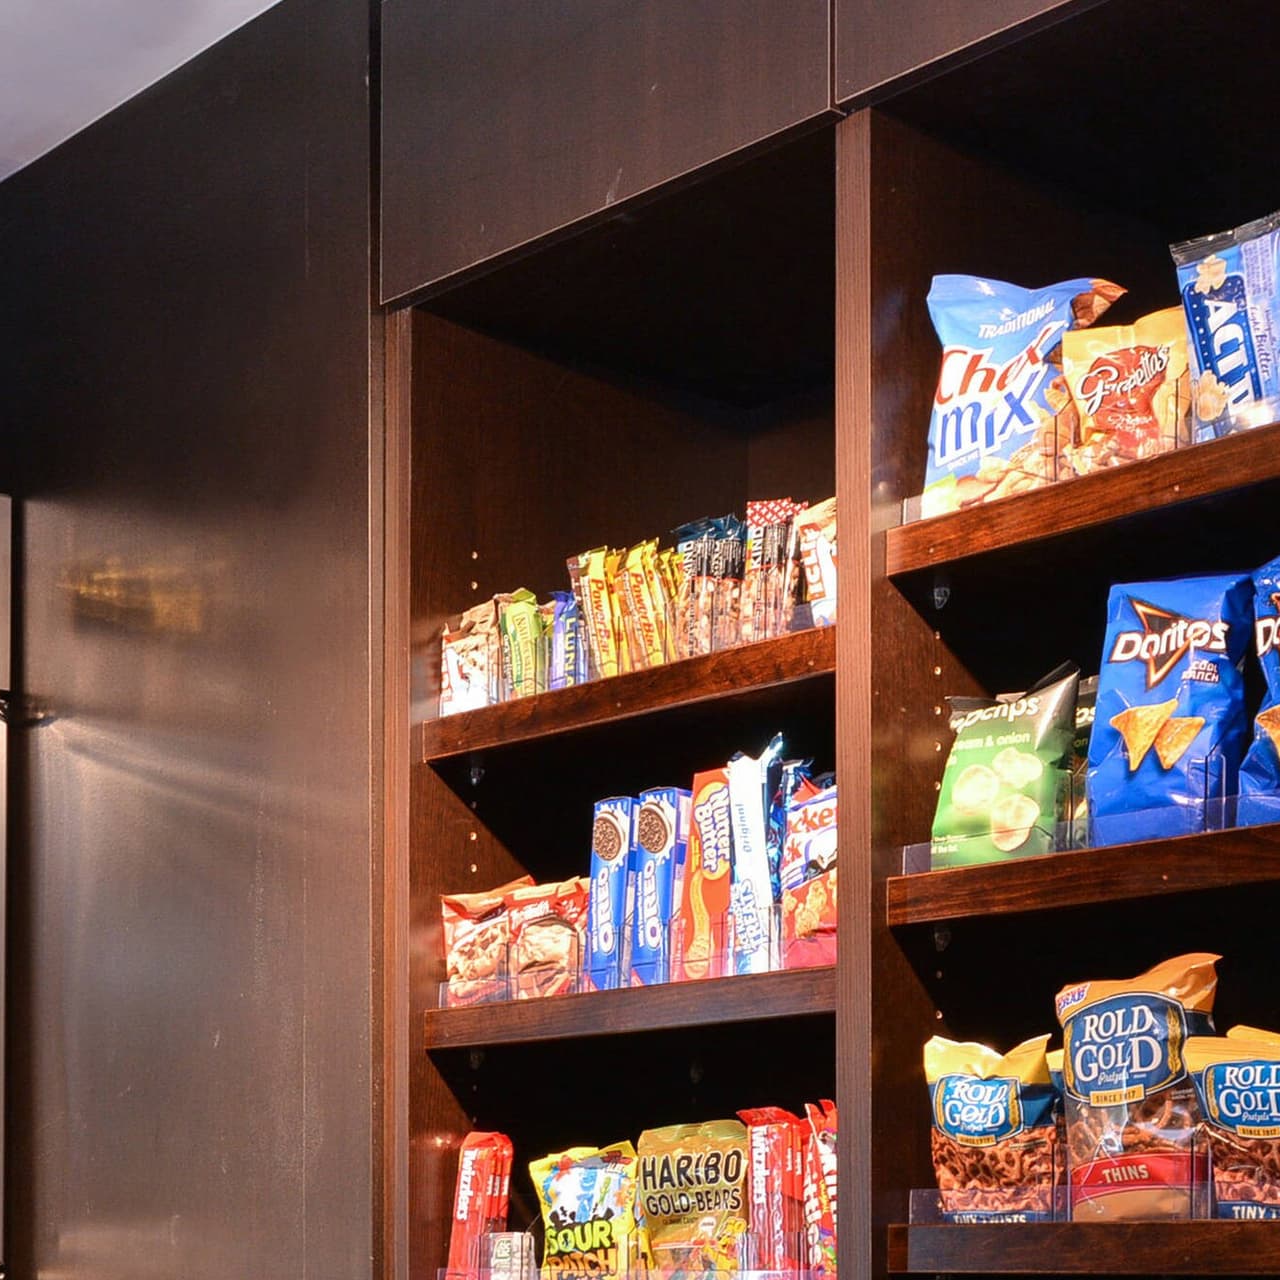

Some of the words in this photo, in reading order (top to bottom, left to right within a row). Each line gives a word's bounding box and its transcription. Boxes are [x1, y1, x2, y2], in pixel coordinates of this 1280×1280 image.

[978, 298, 1057, 339] TRADITIONAL
[935, 320, 1070, 406] Chex
[934, 364, 1048, 464] mix
[590, 579, 610, 655] PowerBar
[1109, 618, 1228, 664] Doritos
[1190, 659, 1220, 672] COOL
[596, 866, 616, 956] OREO
[643, 859, 663, 952] OREO
[1082, 1004, 1156, 1043] ROLD
[1074, 1035, 1163, 1083] GOLD
[641, 1149, 744, 1192] HARIBO
[1102, 1163, 1150, 1184] THINS
[645, 1188, 742, 1217] GOLD-BEARS
[1232, 1204, 1267, 1220] TINY
[545, 1219, 613, 1256] SOUR
